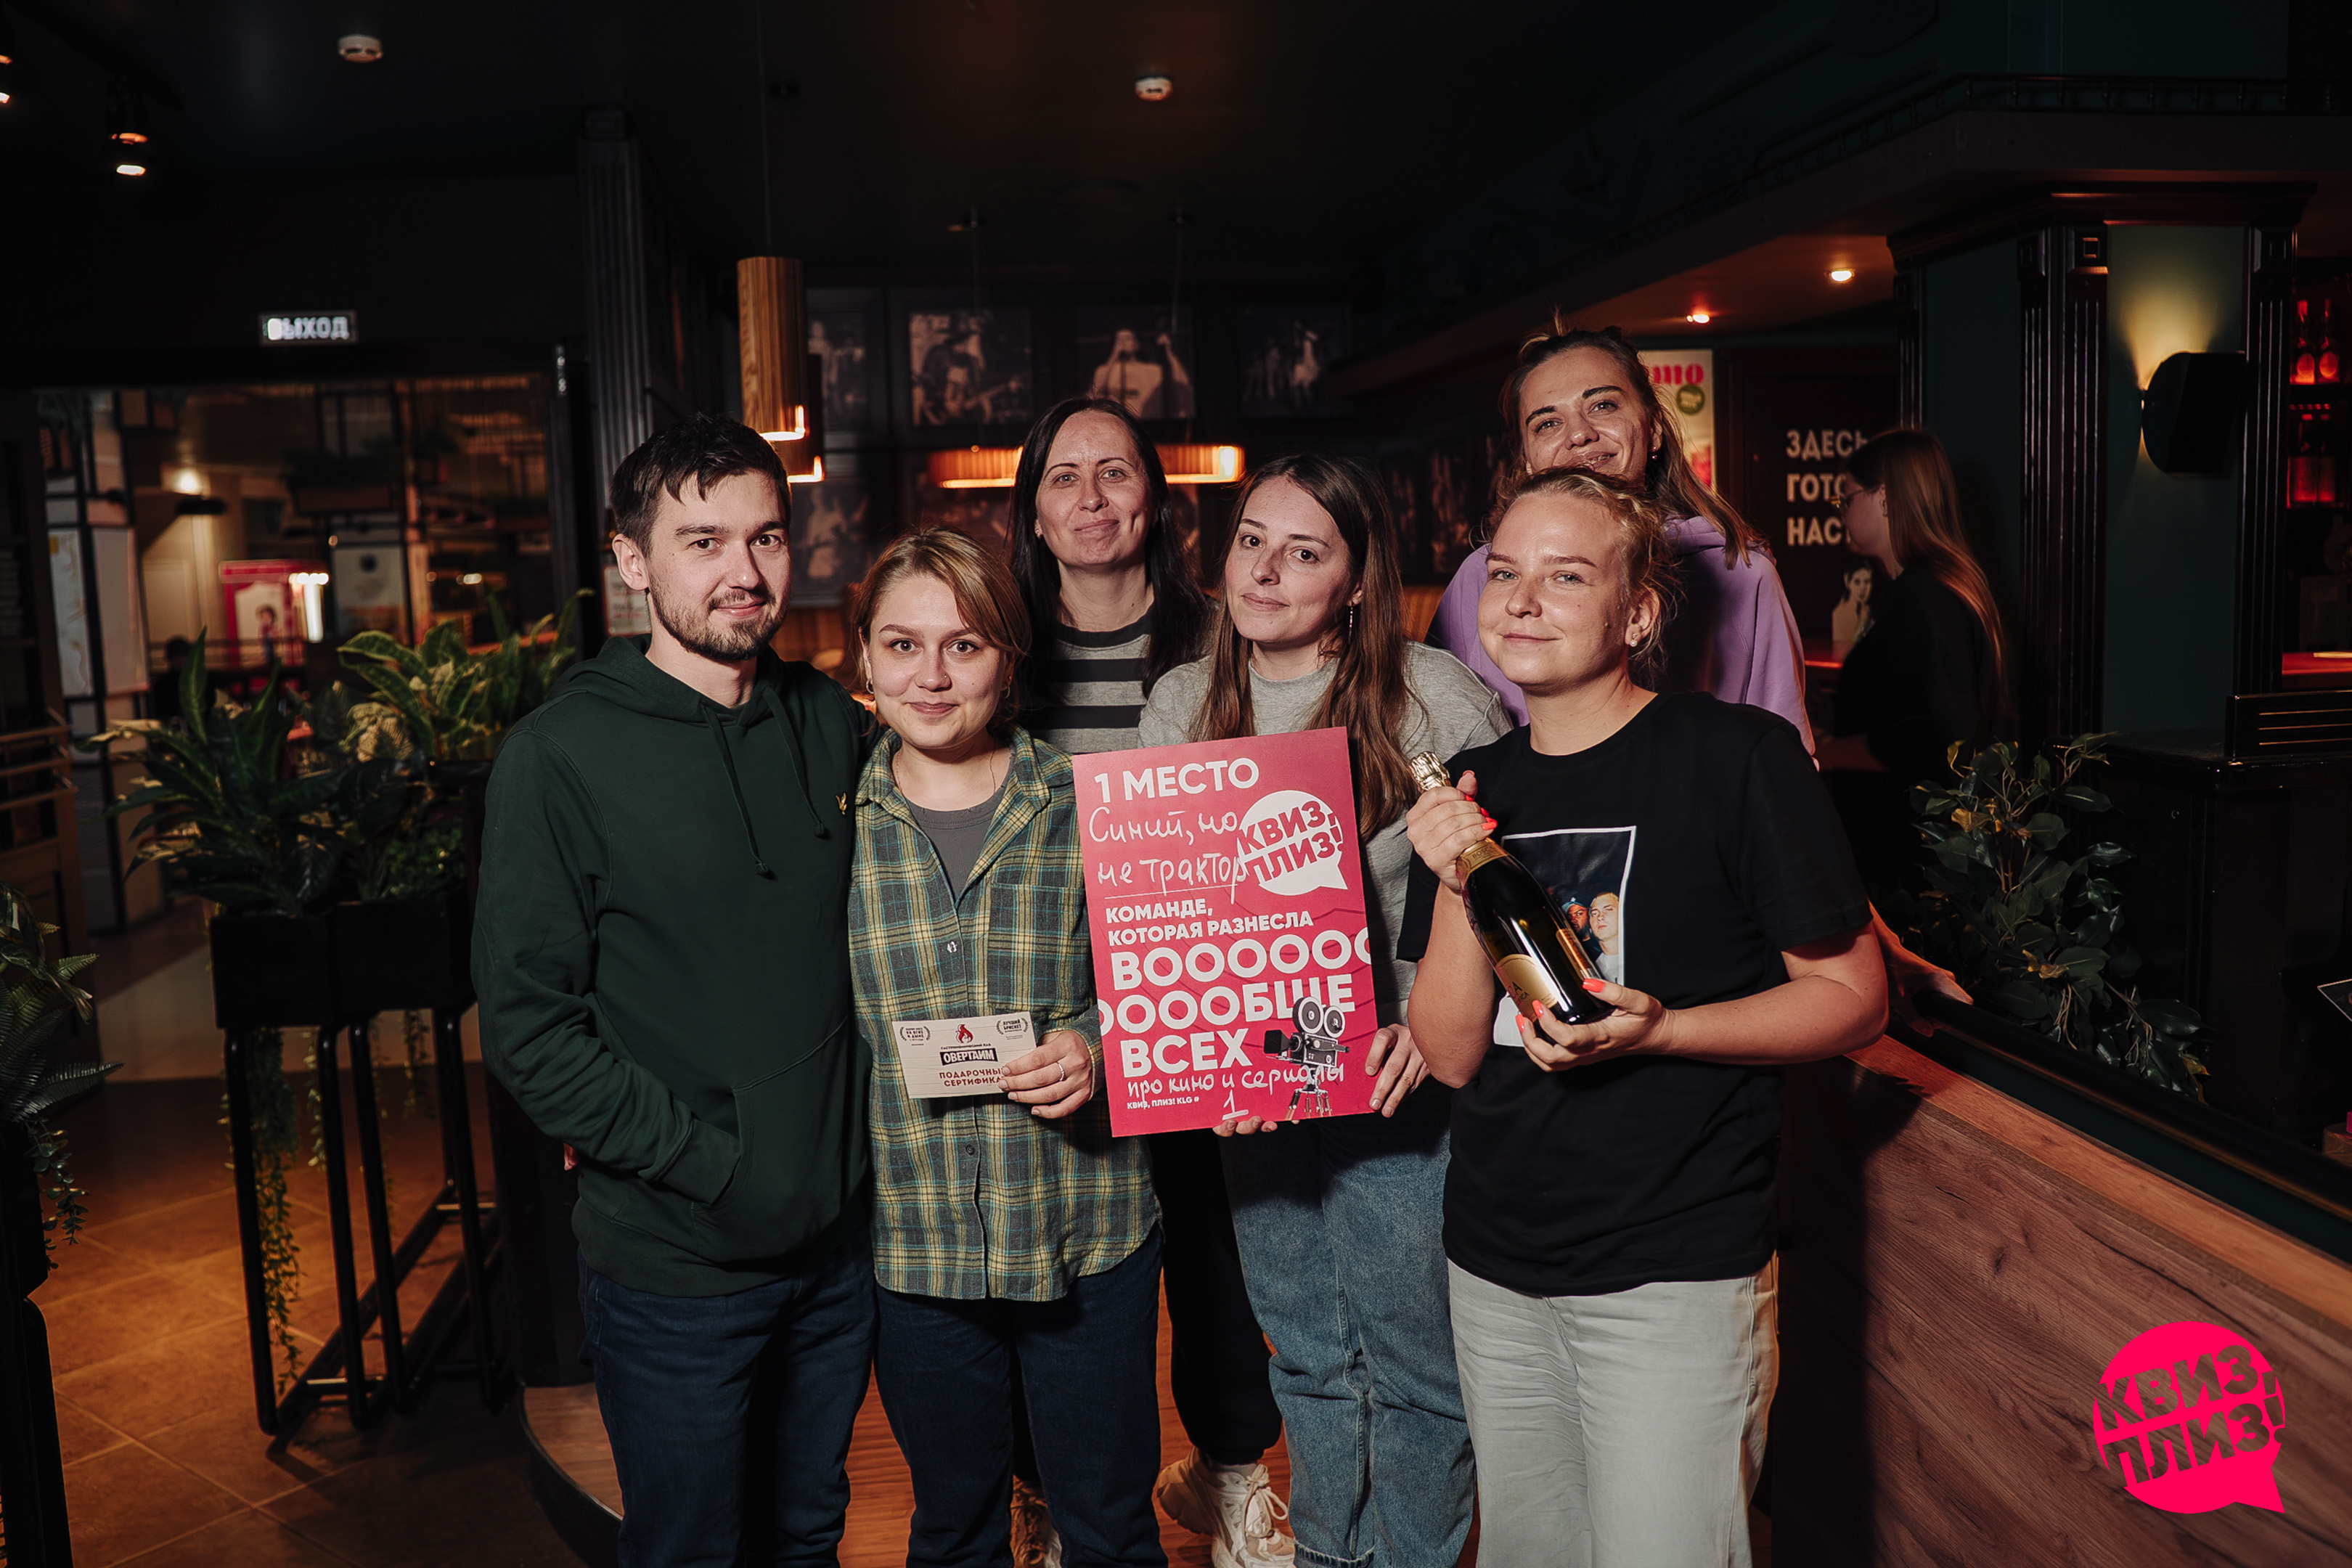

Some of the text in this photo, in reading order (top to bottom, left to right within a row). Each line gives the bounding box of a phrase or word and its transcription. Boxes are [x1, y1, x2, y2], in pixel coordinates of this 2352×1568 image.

[1787, 516, 1850, 546] НАС
[1094, 758, 1259, 803] 1 МЕСТО
[1090, 807, 1193, 846] Синий,
[1098, 862, 1132, 886] не
[1106, 899, 1213, 923] КОМАНДЕ,
[1108, 910, 1314, 946] КОТОРАЯ РАЗНЕСЛА
[1120, 1028, 1253, 1078] ВСЕХ
[939, 1065, 1003, 1079] ПОДАРОЧНЫ
[944, 1076, 1003, 1087] СЕРТИФИКА
[1127, 1079, 1164, 1110] про
[1168, 1074, 1214, 1094] кино
[1222, 1072, 1235, 1088] и
[1151, 1098, 1176, 1107] ПЛИЗ!
[1177, 1096, 1193, 1105] KLG
